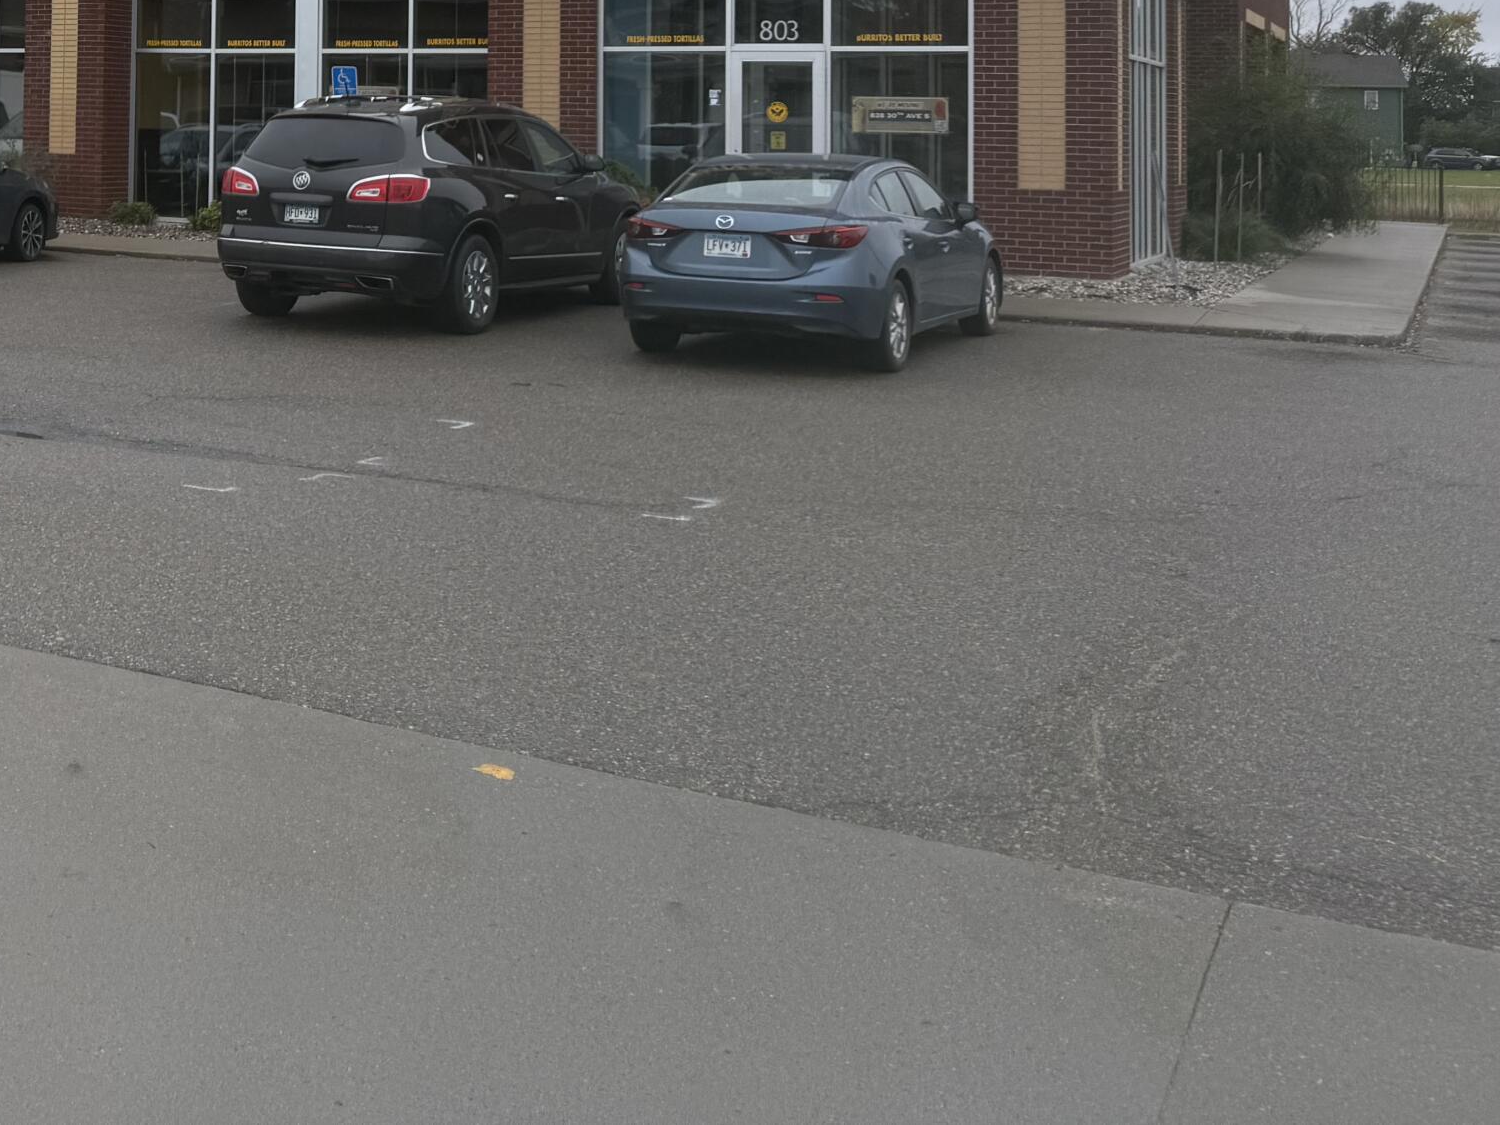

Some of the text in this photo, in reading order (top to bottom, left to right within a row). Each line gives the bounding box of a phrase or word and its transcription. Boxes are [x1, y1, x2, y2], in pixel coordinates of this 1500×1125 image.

[759, 20, 799, 41] 803
[627, 35, 704, 43] FRESH-PRESSED TORTILLAS
[856, 33, 943, 42] BURRITOS BETTER BUILT
